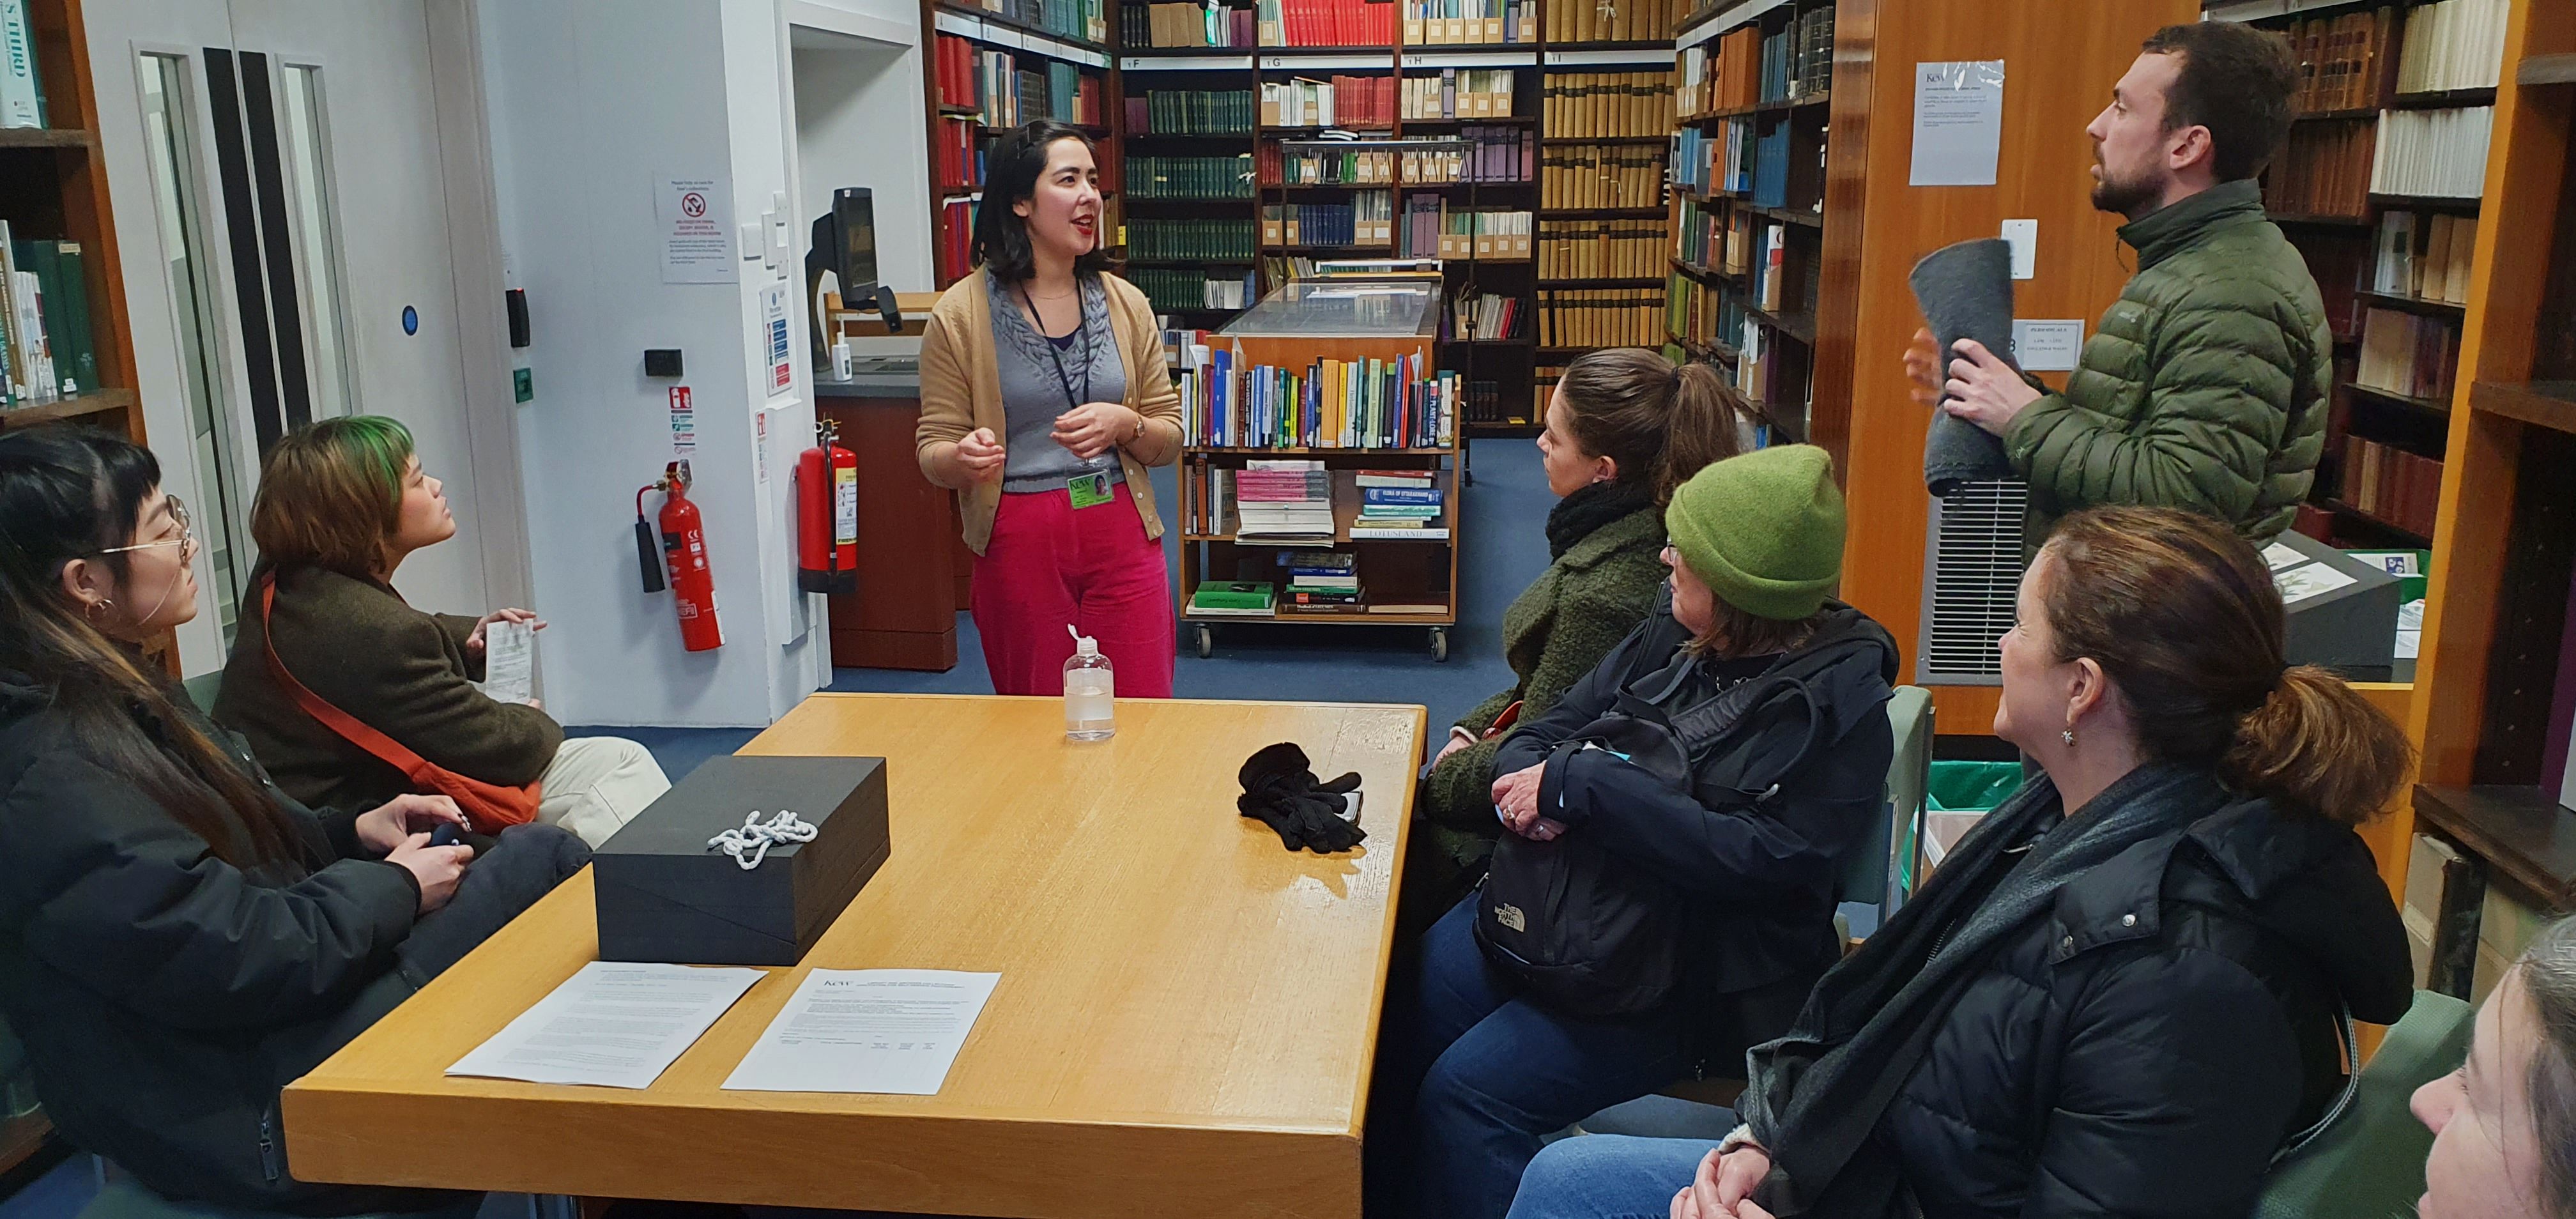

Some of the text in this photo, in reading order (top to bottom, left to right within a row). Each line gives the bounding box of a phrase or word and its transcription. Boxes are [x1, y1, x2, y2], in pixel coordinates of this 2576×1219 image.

[8, 19, 26, 78] THIRD
[1273, 58, 1280, 67] G
[1414, 56, 1422, 65] H
[1494, 905, 1514, 921] NORTH
[1503, 903, 1517, 914] THE
[1498, 914, 1514, 928] FACE
